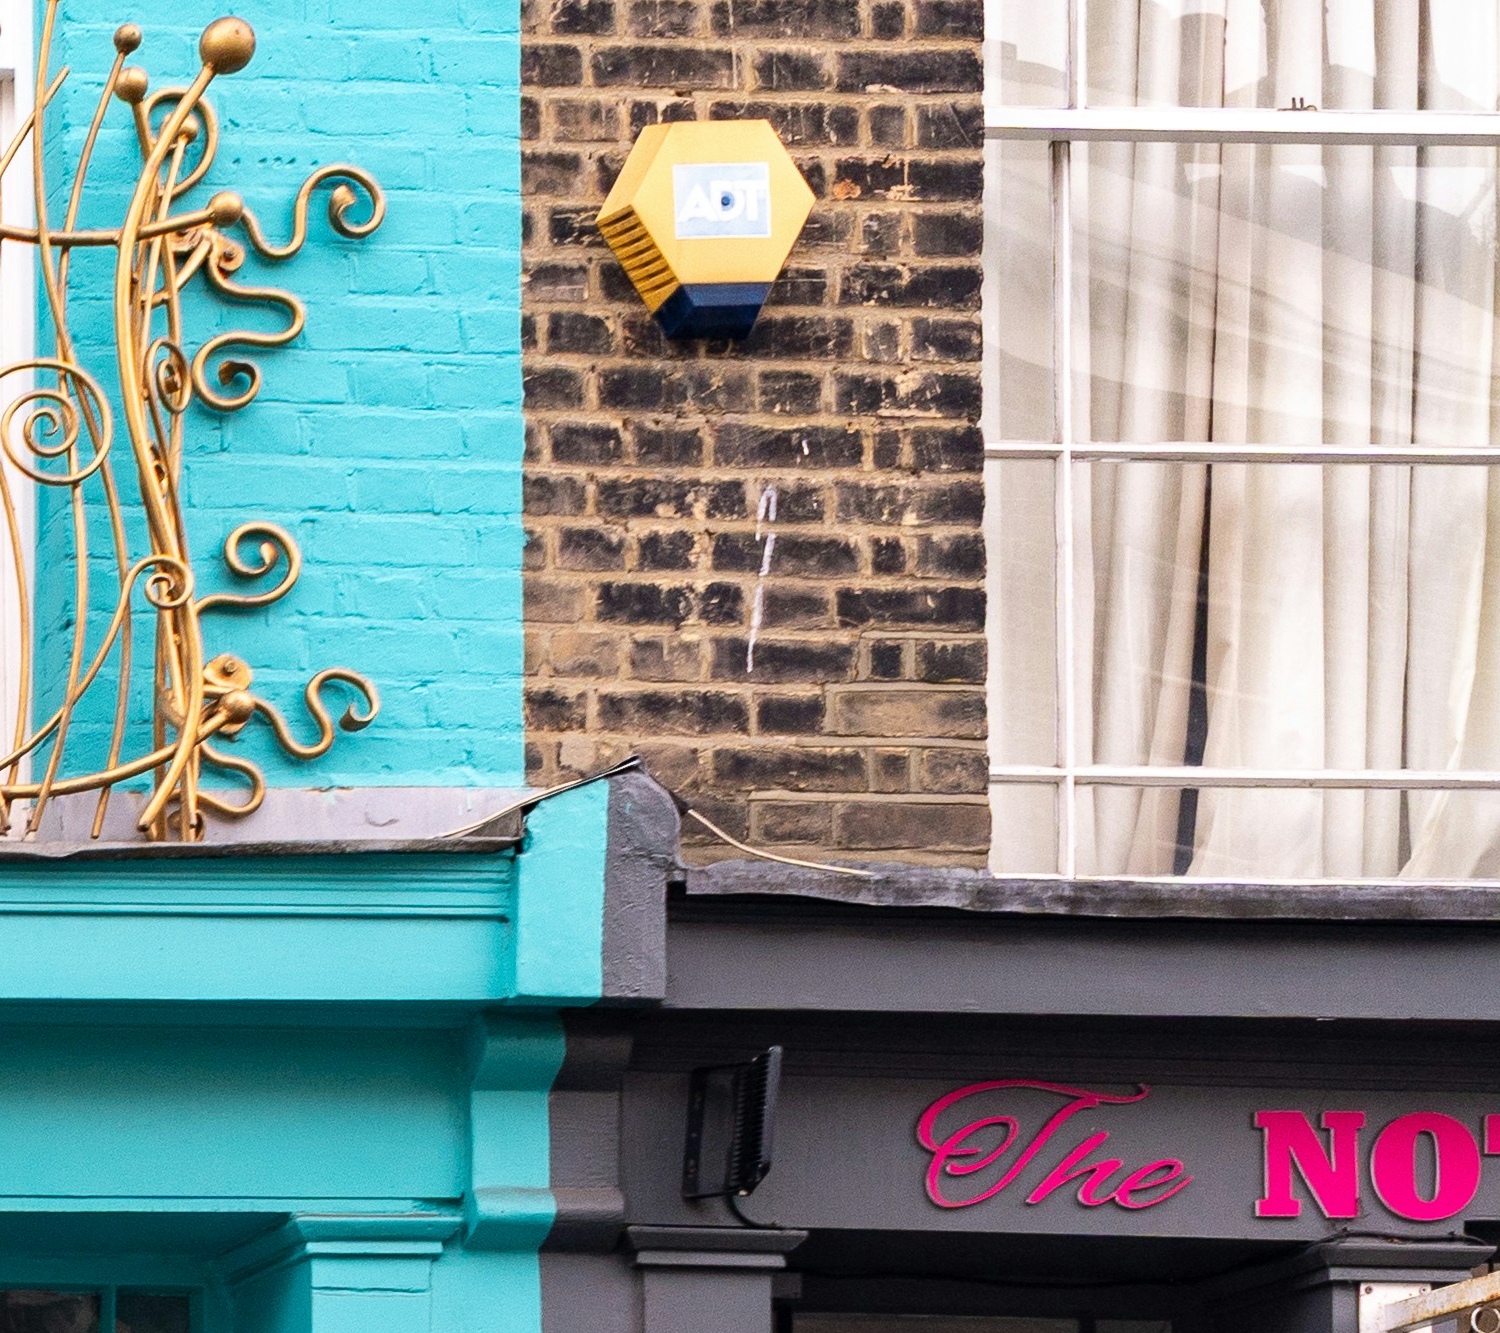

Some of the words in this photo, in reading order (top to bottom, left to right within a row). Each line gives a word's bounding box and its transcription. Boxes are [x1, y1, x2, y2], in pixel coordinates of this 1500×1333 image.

[677, 179, 768, 223] ADT
[916, 1078, 1194, 1209] The
[1254, 1109, 1500, 1222] NO
